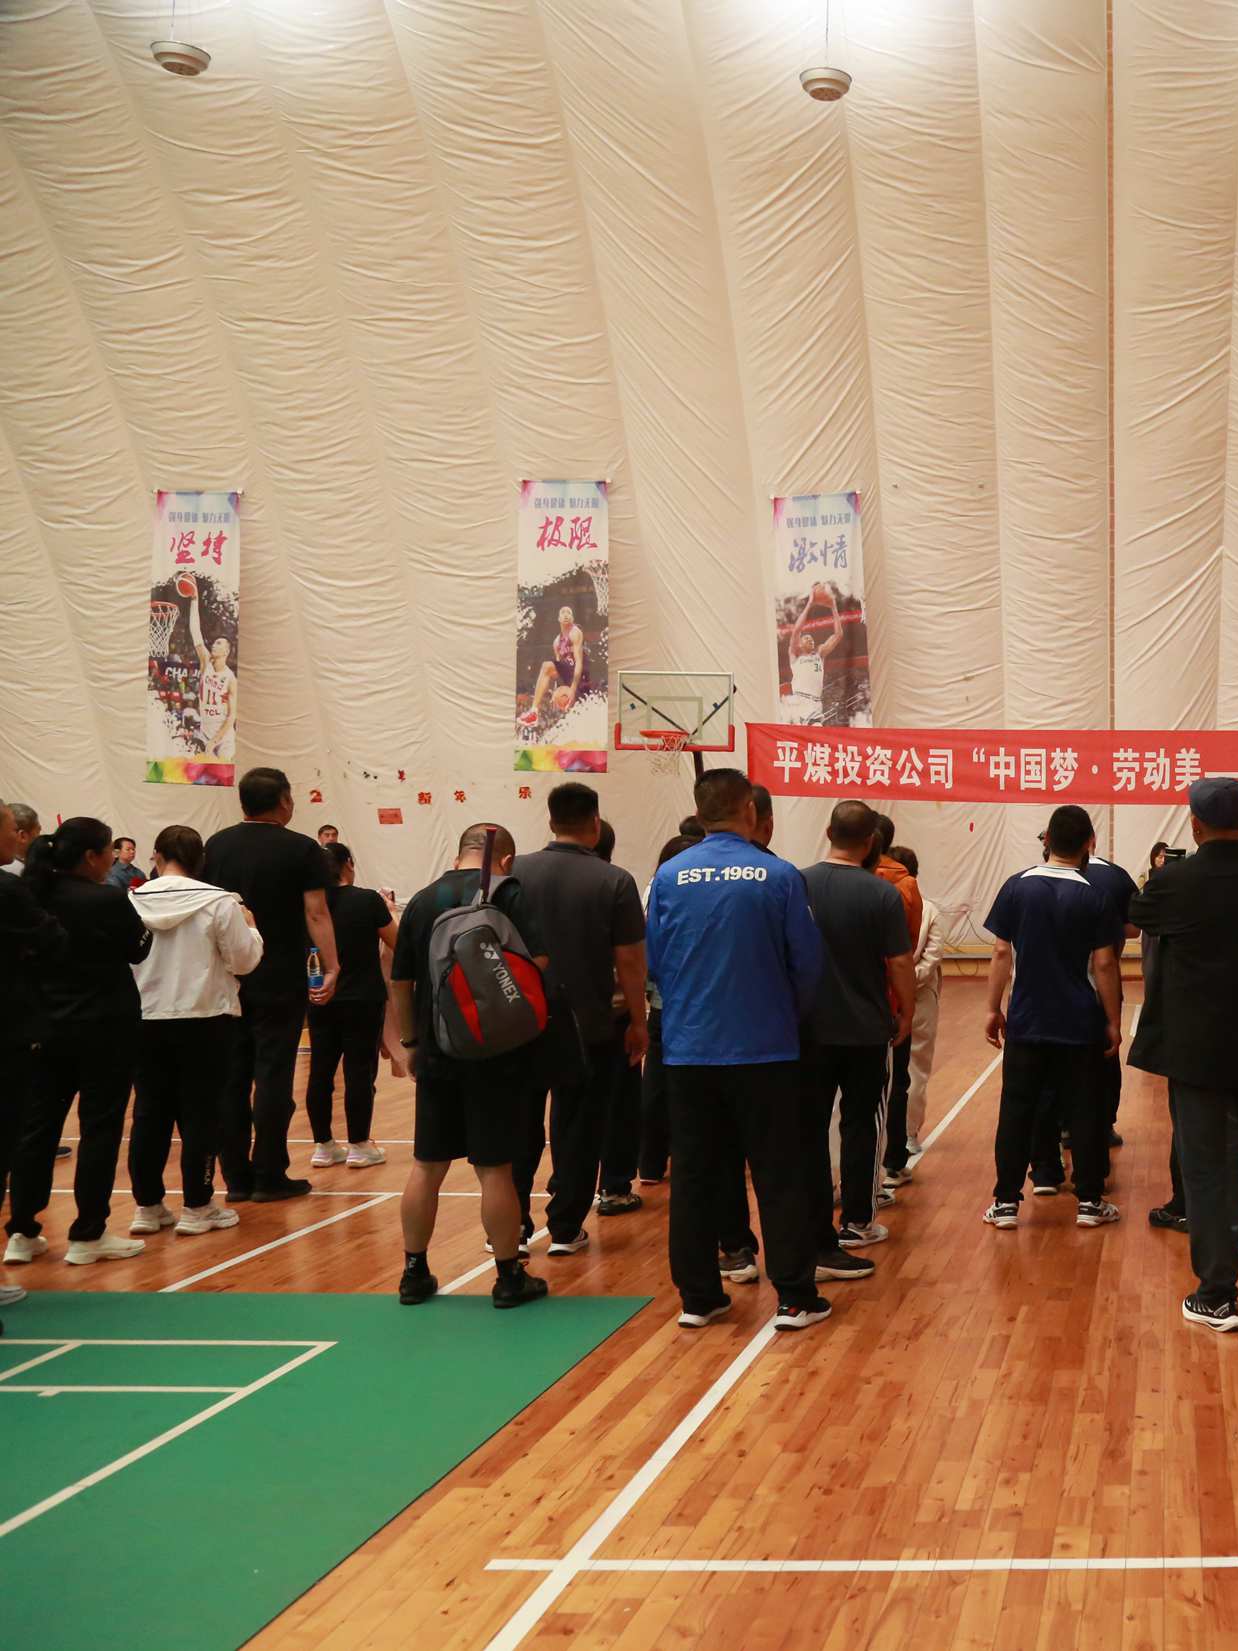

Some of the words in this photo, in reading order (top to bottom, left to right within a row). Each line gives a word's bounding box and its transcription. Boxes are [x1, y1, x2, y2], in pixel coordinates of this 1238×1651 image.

[169, 530, 228, 565] 坚持
[536, 516, 598, 551] 极限
[788, 534, 848, 573] 激情
[677, 866, 768, 886] EST.1960
[492, 961, 521, 1004] YONEX
